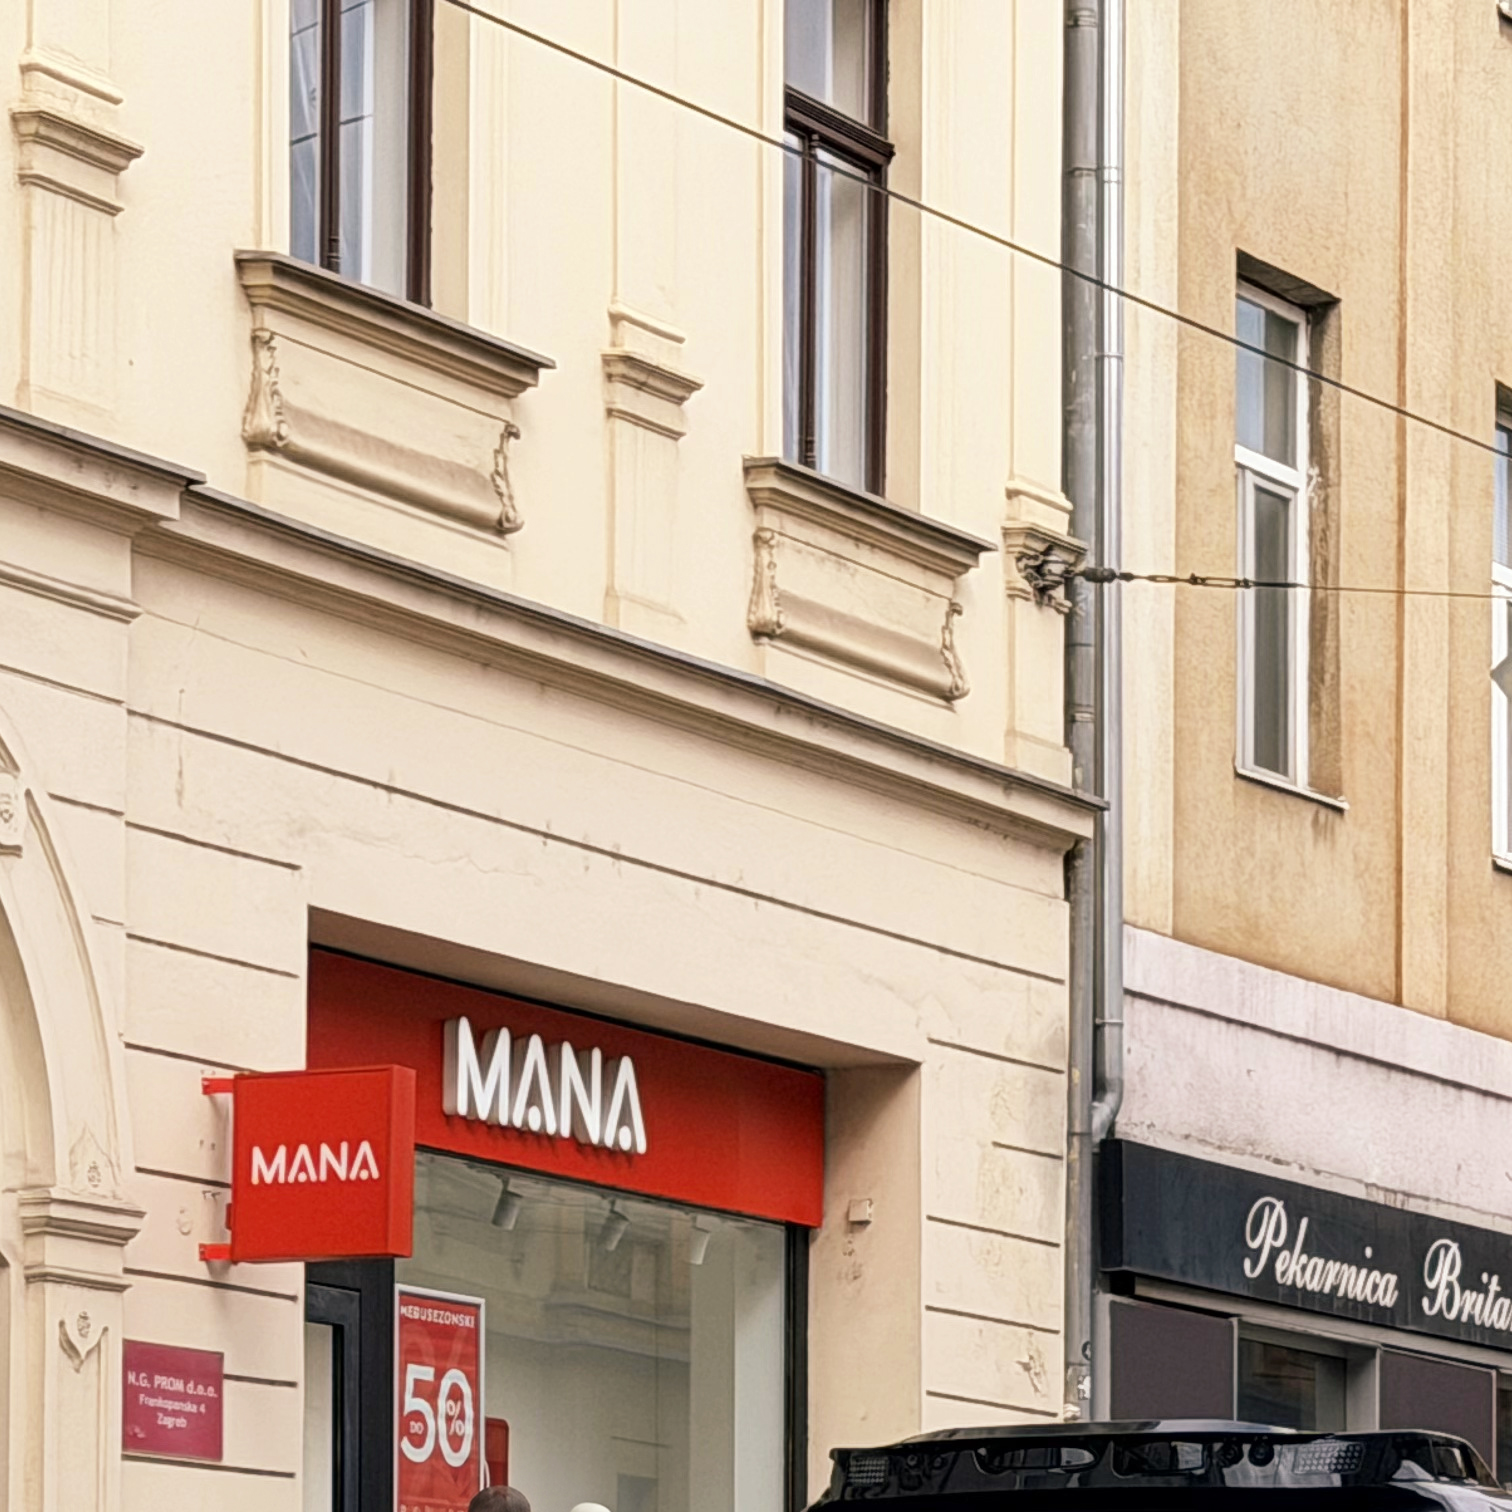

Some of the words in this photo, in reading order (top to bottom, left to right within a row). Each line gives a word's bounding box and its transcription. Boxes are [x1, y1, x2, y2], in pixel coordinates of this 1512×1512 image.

[450, 1016, 647, 1154] MANA
[251, 1140, 380, 1185] MANA
[1243, 1196, 1399, 1308] Pekarnica
[153, 1374, 185, 1393] PROM
[400, 1363, 474, 1468] 50
[409, 1420, 425, 1434] DO
